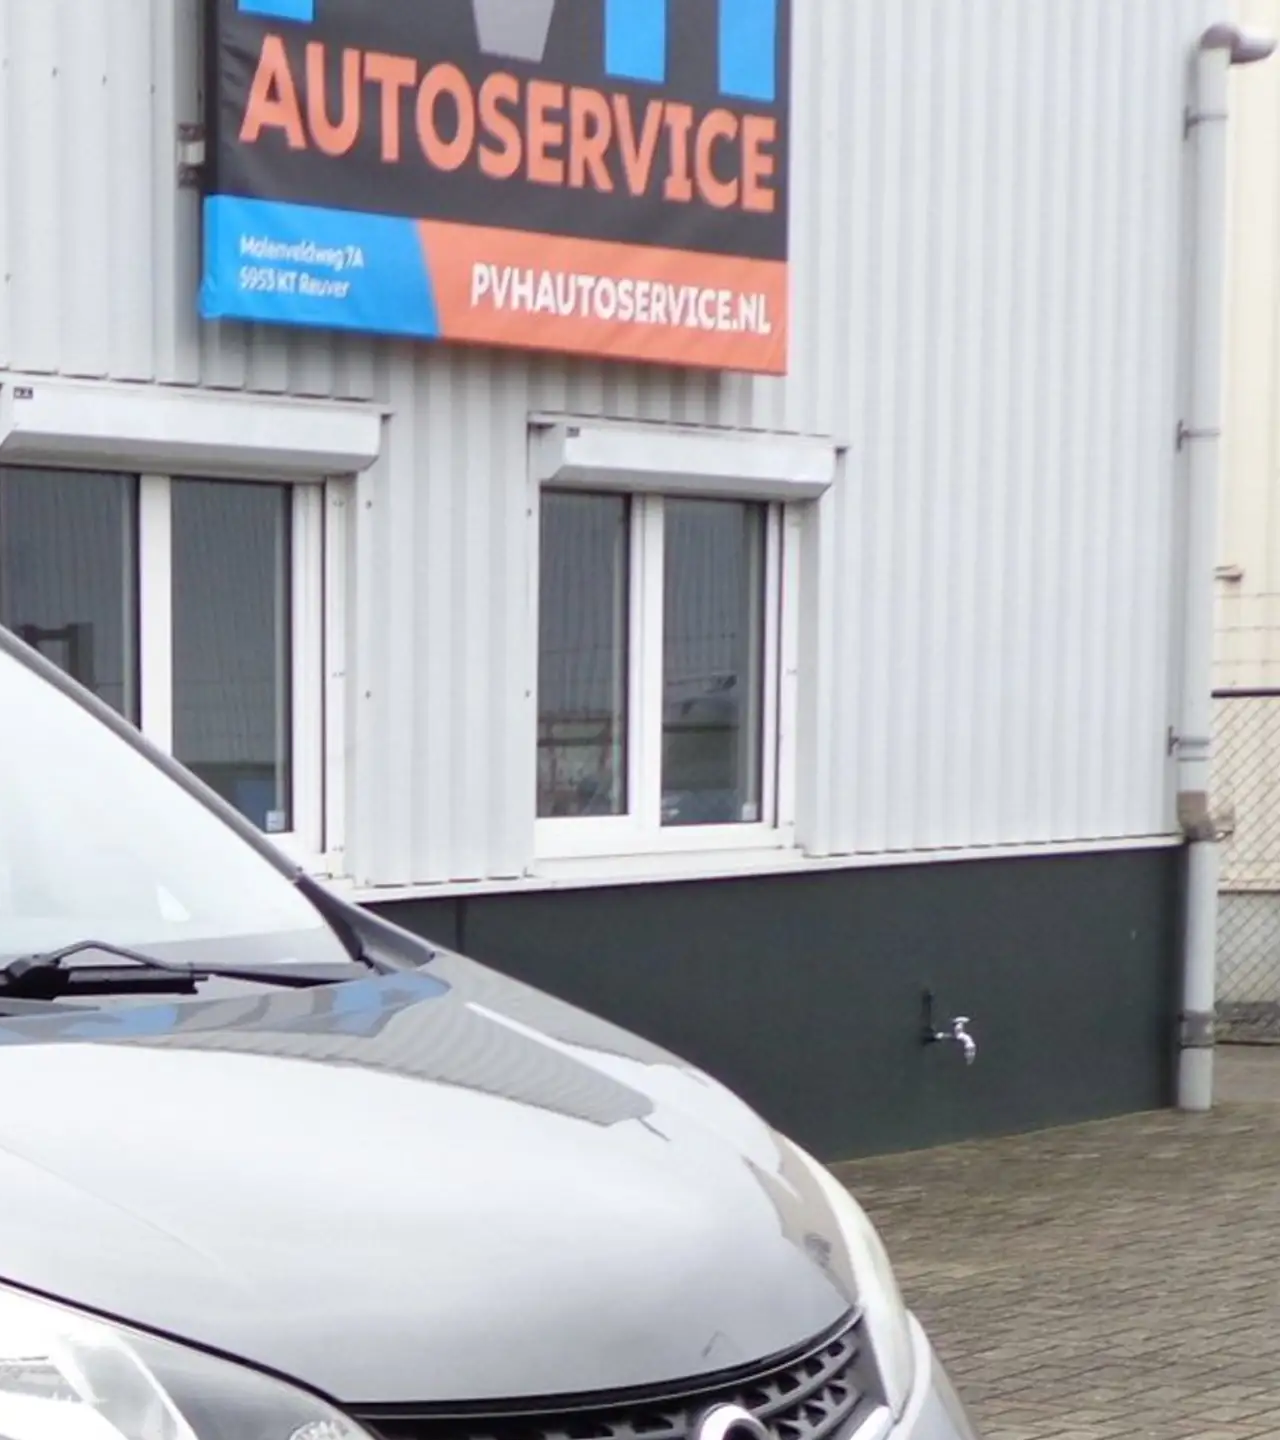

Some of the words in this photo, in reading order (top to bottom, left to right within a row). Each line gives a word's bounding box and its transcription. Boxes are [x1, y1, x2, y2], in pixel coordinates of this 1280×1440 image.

[240, 33, 775, 213] AUTOSERVICE
[277, 270, 298, 294] KT
[299, 271, 351, 299] Reuver
[471, 261, 772, 335] PVHAUTOSERVICE.NL
